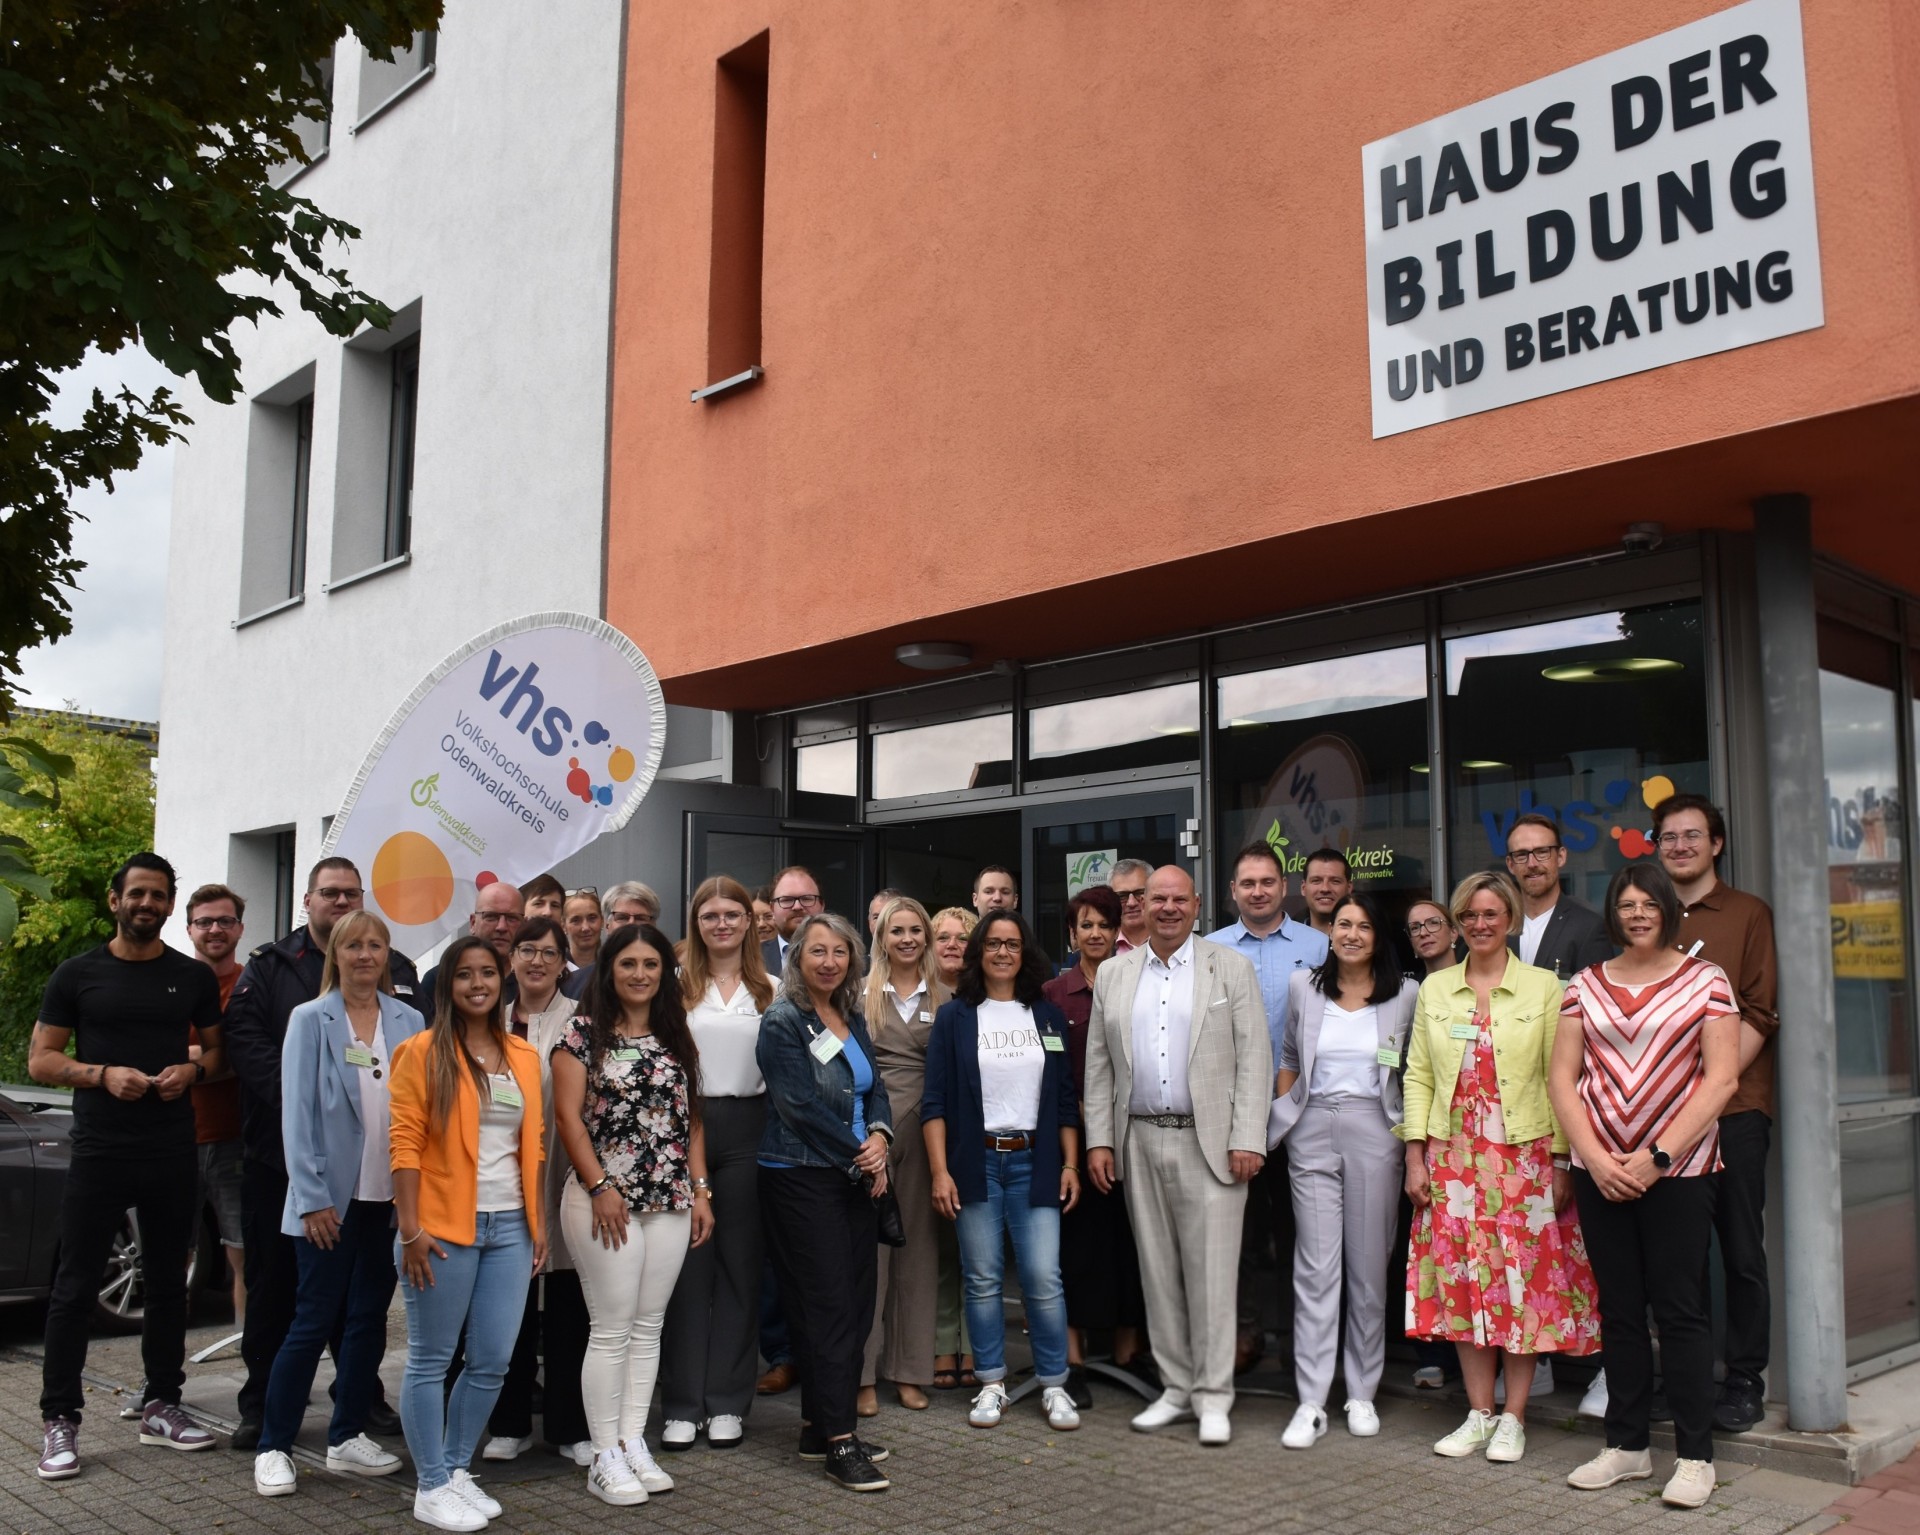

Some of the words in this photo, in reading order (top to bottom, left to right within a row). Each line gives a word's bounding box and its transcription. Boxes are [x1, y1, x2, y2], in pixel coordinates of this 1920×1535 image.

[1380, 101, 1580, 231] HAUS
[1611, 33, 1778, 152] DER
[1383, 139, 1788, 326] BILDUNG
[1387, 337, 1485, 402] UND
[1505, 249, 1793, 372] BERATUNG
[479, 648, 573, 757] vhs
[440, 733, 546, 834] Odenwaldkreis
[454, 709, 570, 822] Volkshochschule
[1357, 868, 1394, 880] Innovativ.
[997, 1051, 1025, 1059] PARIS
